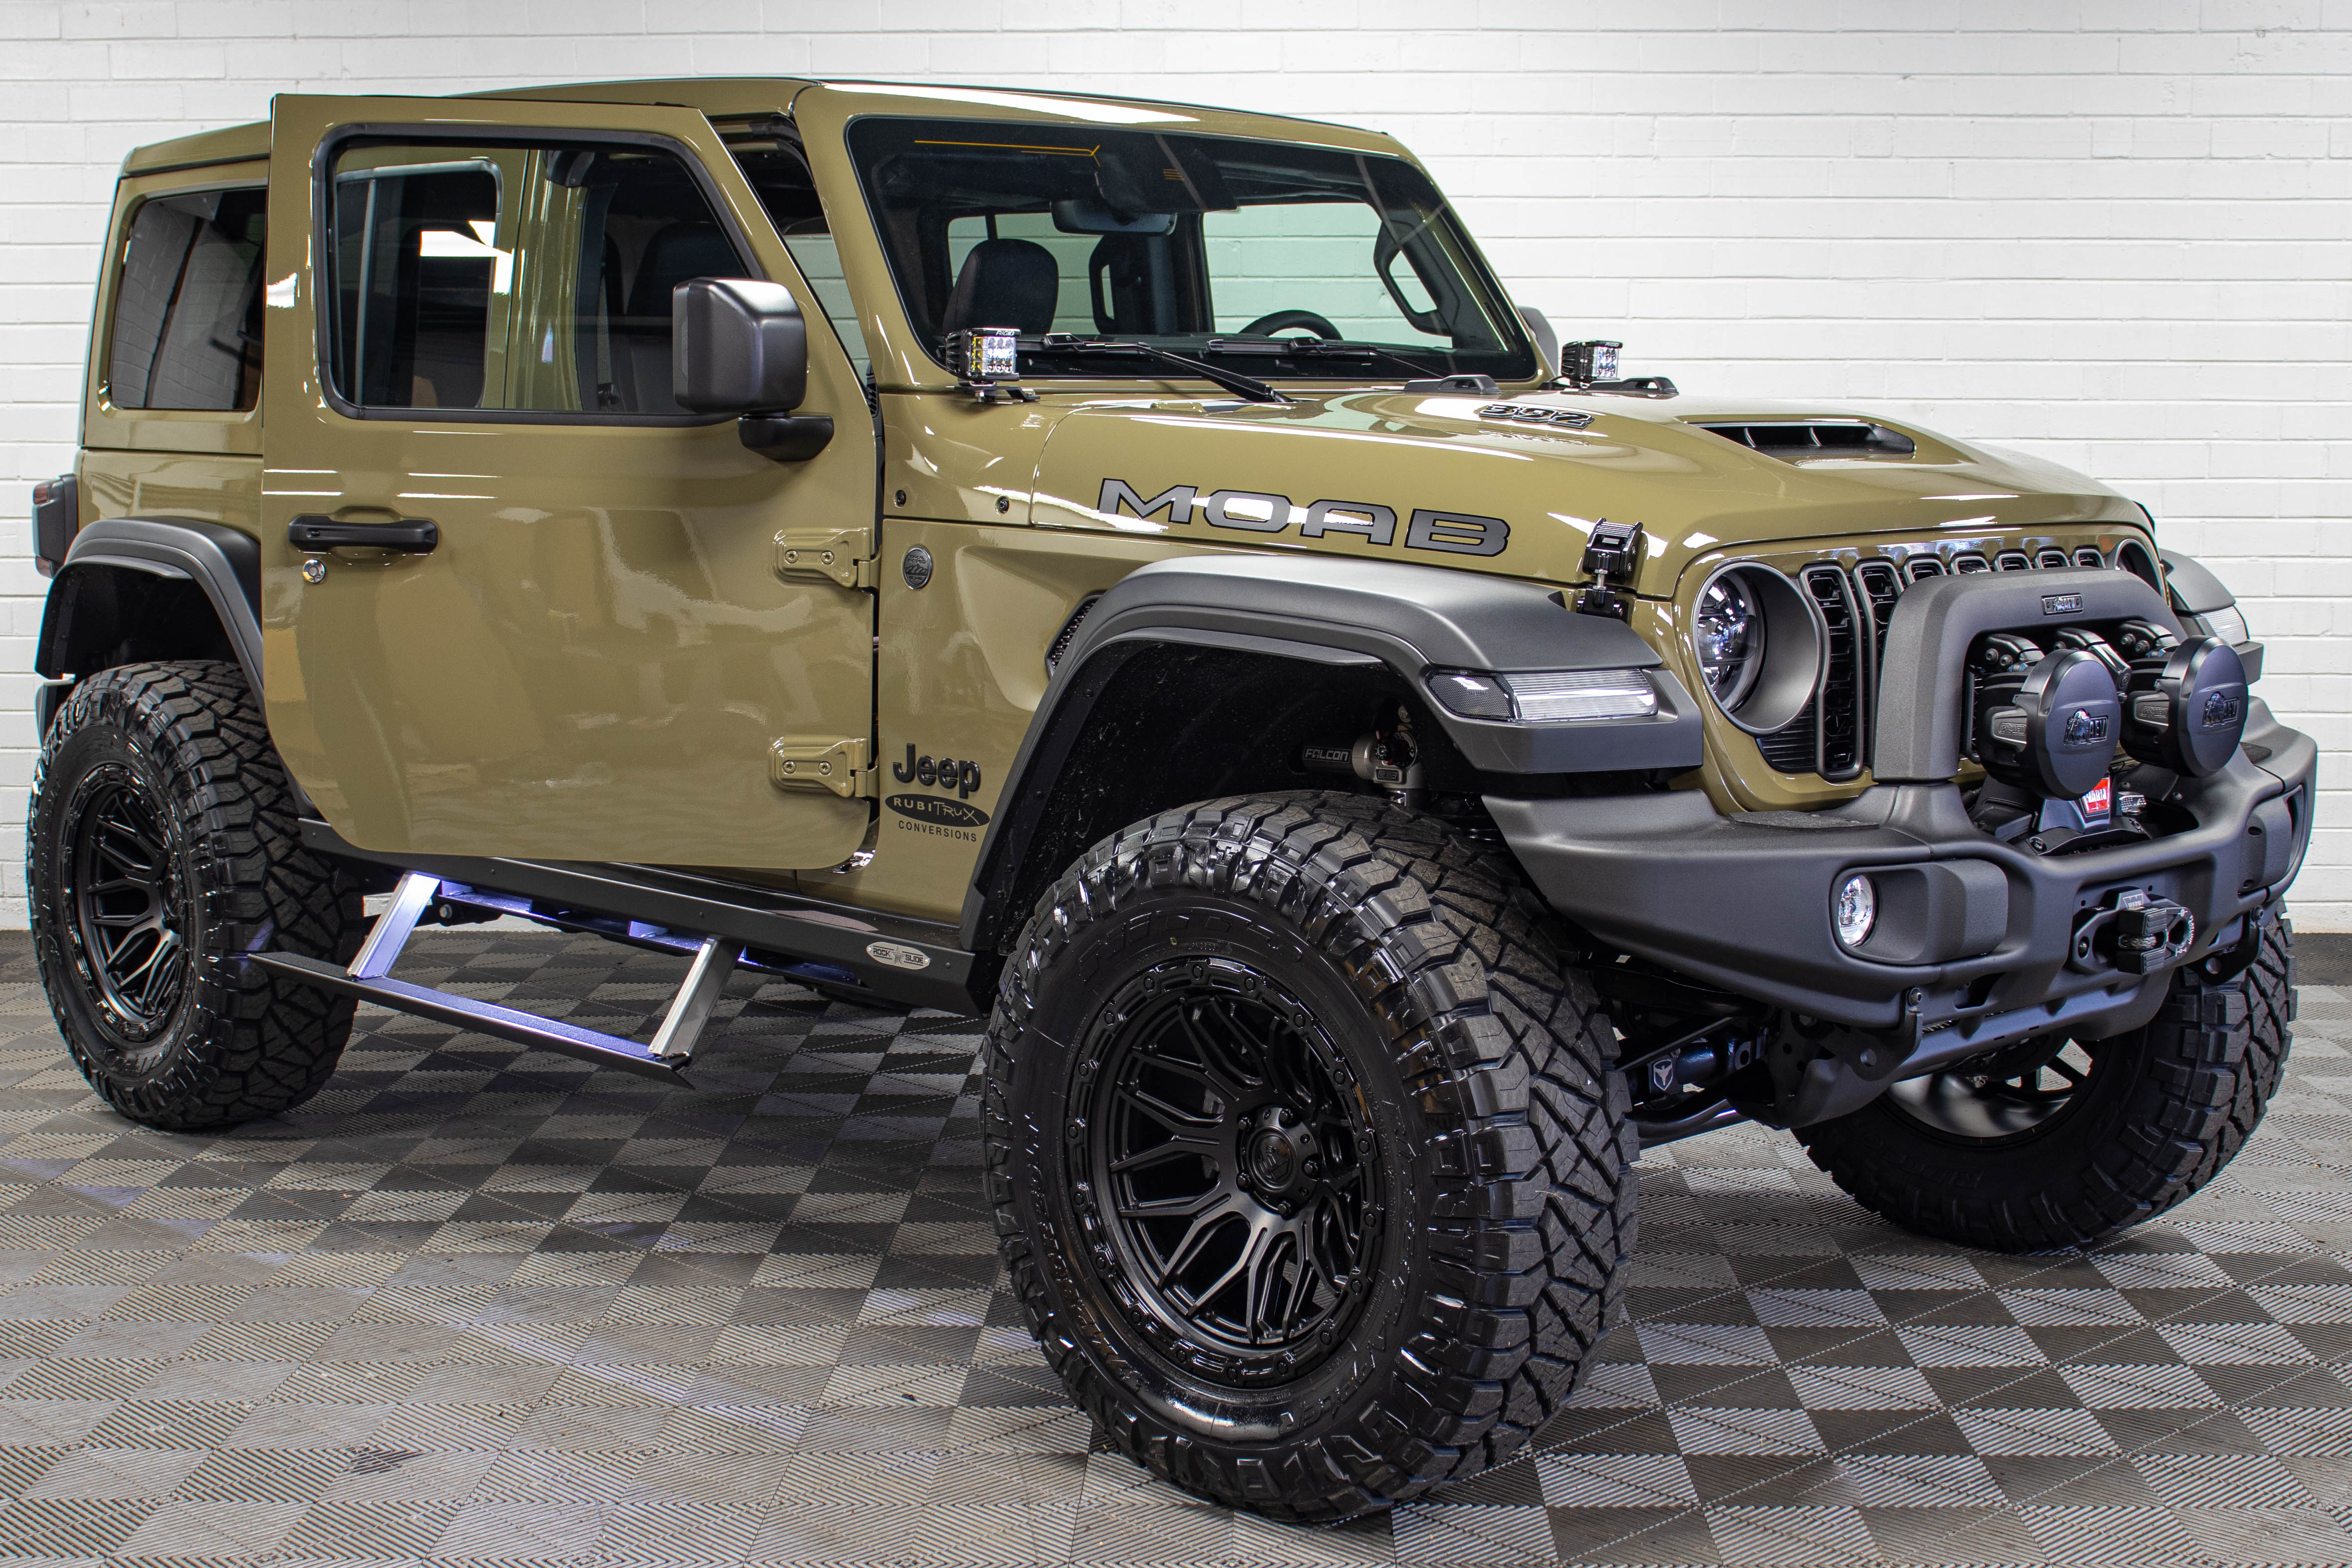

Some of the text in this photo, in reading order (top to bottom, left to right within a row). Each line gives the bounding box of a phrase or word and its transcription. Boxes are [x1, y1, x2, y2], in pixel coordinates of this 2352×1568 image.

[1479, 404, 1595, 430] 392
[1098, 477, 1511, 558] MOAB
[1304, 748, 1349, 762] FALCON
[893, 743, 981, 799] Jeep
[898, 820, 977, 842] CONVERSIONS
[873, 947, 924, 964] ROCK SLIDE
